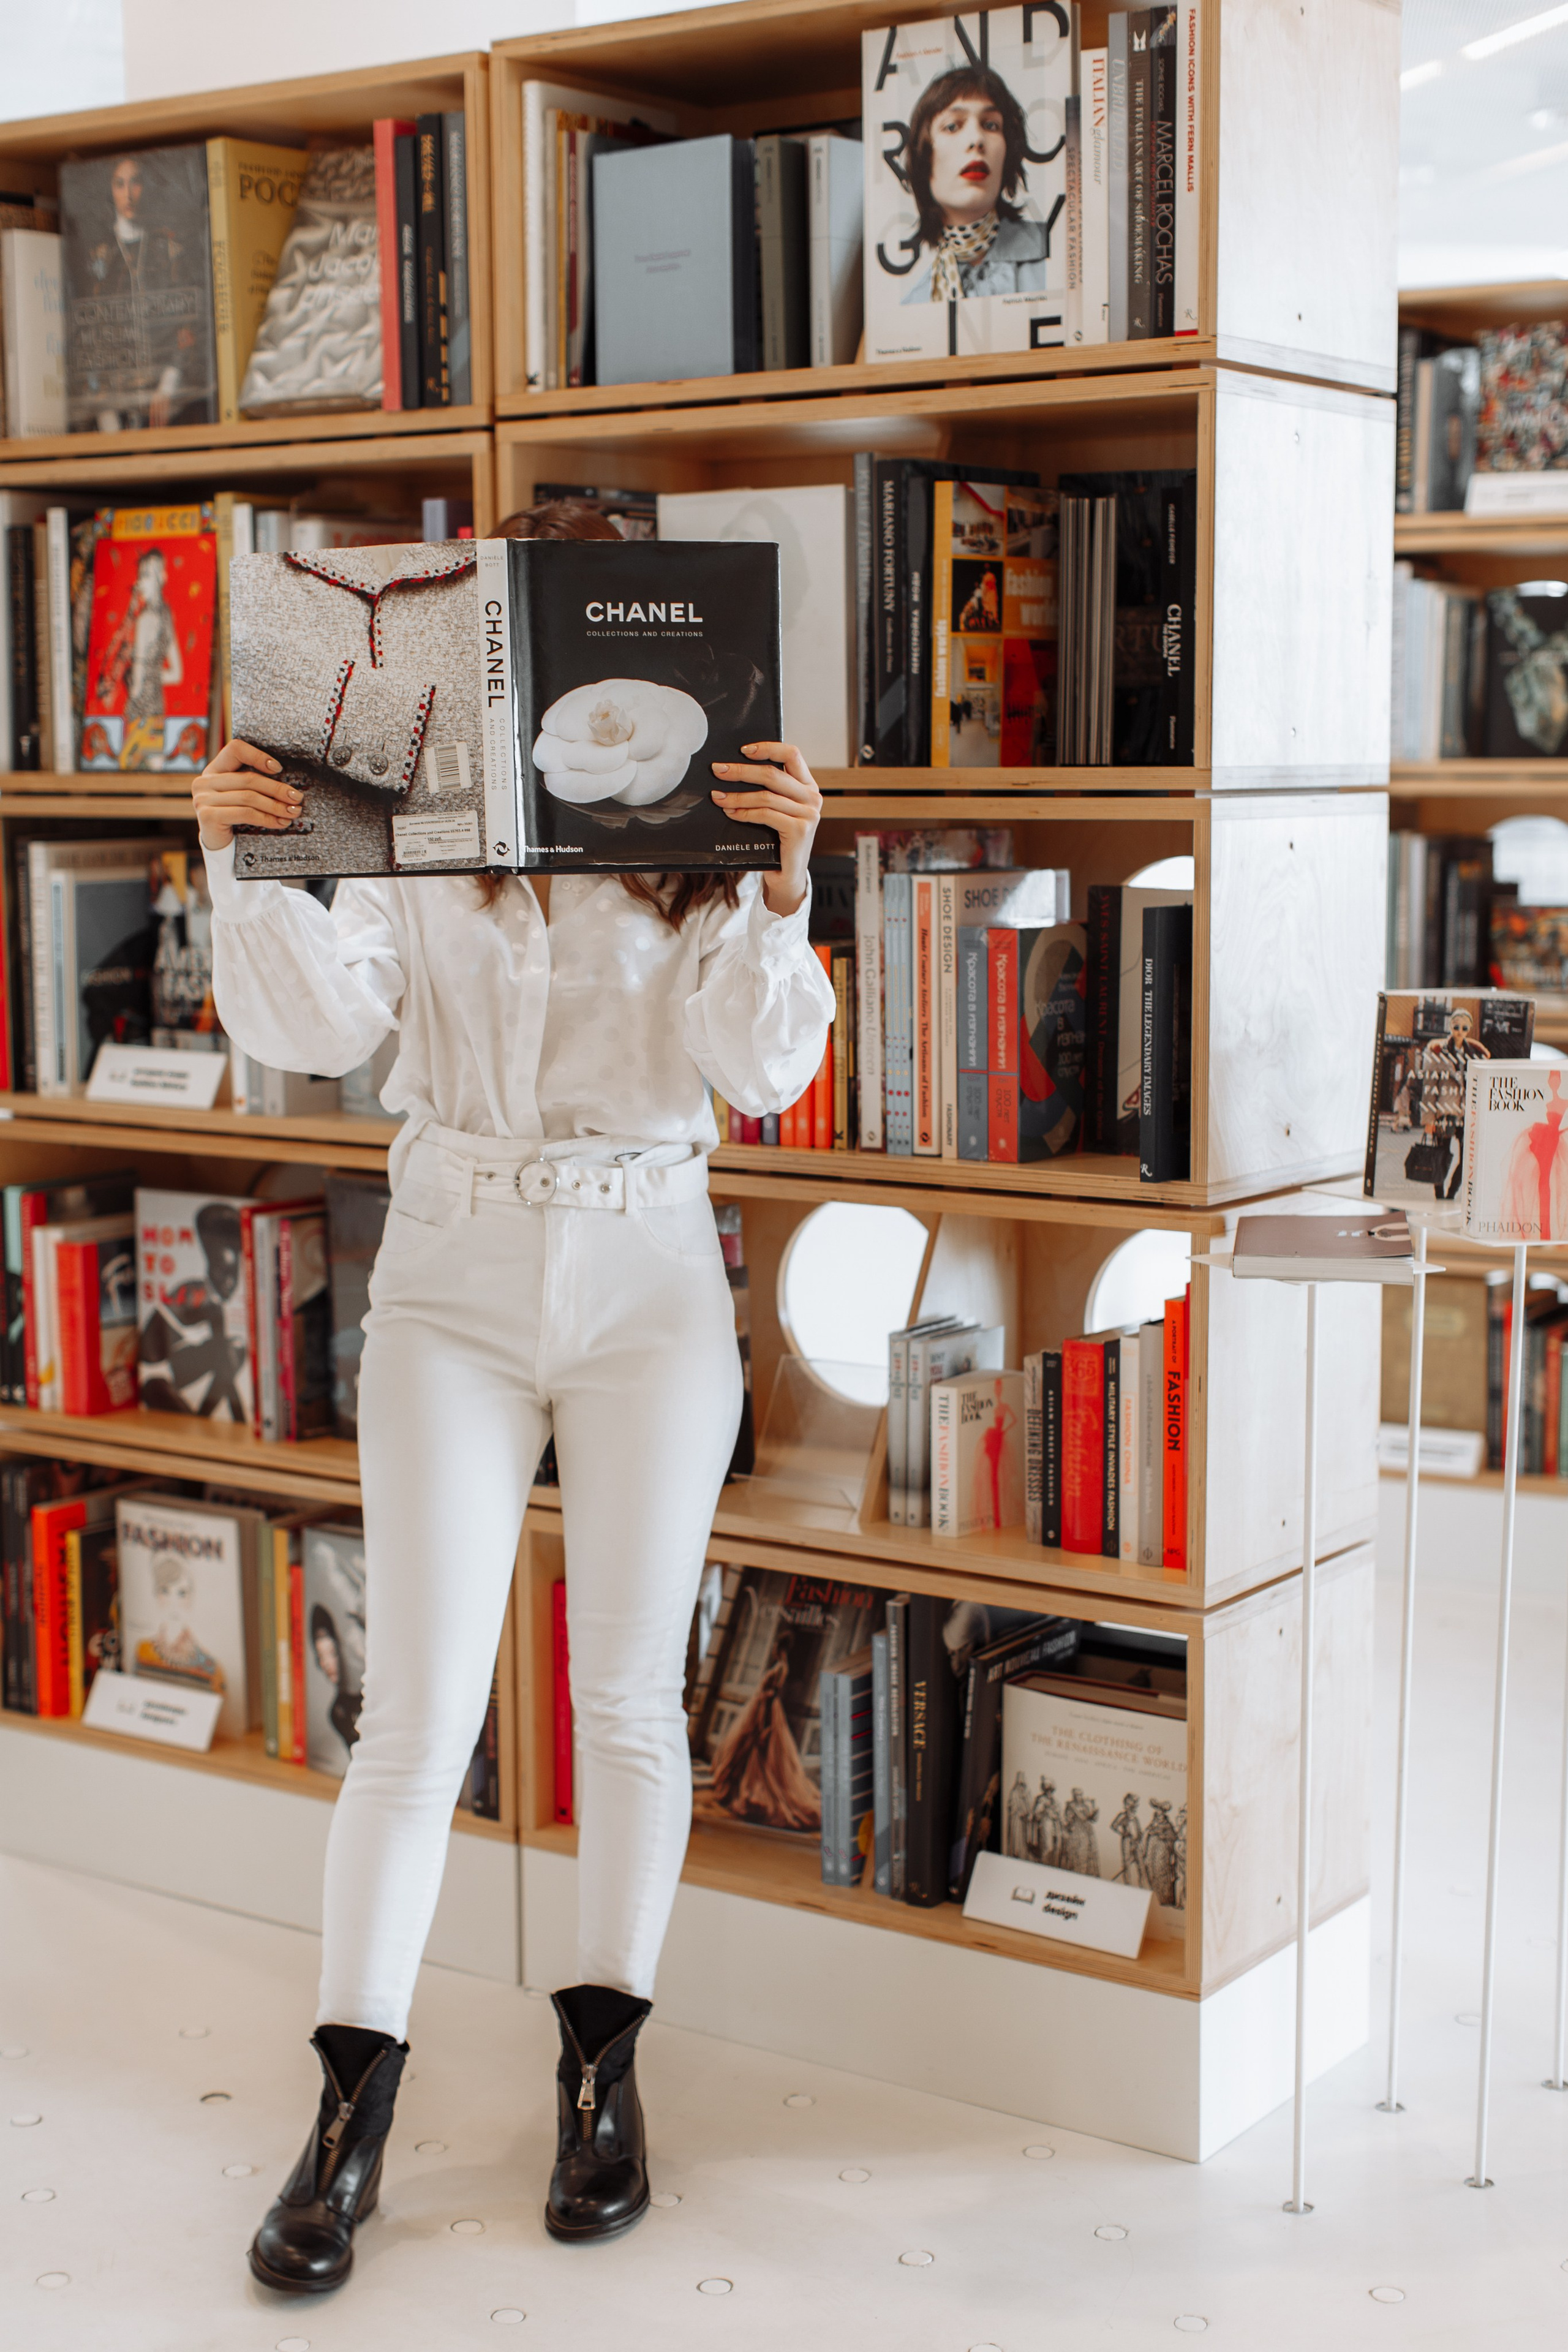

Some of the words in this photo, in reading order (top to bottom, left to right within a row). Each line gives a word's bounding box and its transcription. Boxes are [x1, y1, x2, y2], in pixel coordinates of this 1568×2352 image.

[1093, 58, 1105, 127] ITALIAN
[1134, 79, 1144, 104] THE
[1134, 107, 1144, 156] ITALIAN
[1090, 127, 1105, 184] glamour
[1134, 159, 1144, 183] ART
[1156, 121, 1174, 198] MARCEL
[1067, 148, 1076, 232] SPECTACULAR
[1134, 184, 1144, 199] OF
[1134, 203, 1144, 284] SHOEMAKING
[1155, 203, 1173, 285] ROCHAS
[1067, 238, 1076, 290] FASHION
[883, 480, 895, 547] MARIANO
[883, 549, 895, 612] FORTUNY
[586, 601, 703, 622] CHANEL
[485, 600, 505, 708] CHANEL
[1167, 604, 1182, 677] CHANEL
[499, 718, 508, 791] COLLECTIONS
[715, 843, 750, 851] DANIÈLE
[943, 888, 952, 921] SHOE
[963, 888, 998, 909] SHOE
[864, 935, 876, 965] John
[943, 925, 953, 974] DESIGN
[966, 952, 978, 1002] Красота
[995, 954, 1008, 1004] Красота
[1144, 958, 1153, 984] DIOR
[864, 967, 877, 1023] Galliano
[1144, 990, 1153, 1012] THE
[1144, 1013, 1153, 1074] LEGENDARY
[921, 1075, 929, 1084] of
[1407, 1069, 1450, 1080] ASIAN
[1424, 1085, 1463, 1096] FASHI
[1489, 1088, 1545, 1101] FASHION
[1490, 1077, 1518, 1088] THE
[1143, 1076, 1152, 1115] IMAGES
[1488, 1099, 1526, 1112] BOOK
[1468, 1109, 1477, 1180] FASHION
[1479, 1221, 1543, 1234] PHAIDON
[144, 1253, 177, 1275] TO
[938, 1394, 950, 1425] THE
[1107, 1381, 1116, 1421] MILITARY
[1167, 1370, 1181, 1451] FASHION
[1107, 1422, 1116, 1449] STYLE
[938, 1425, 950, 1487] FASHION
[1107, 1450, 1116, 1489] INVADES
[1027, 1458, 1042, 1502] DRESSES
[938, 1487, 950, 1532] BOOK
[1107, 1490, 1115, 1531] FASHION
[122, 1521, 223, 1561] FASHION
[913, 1681, 928, 1750] VERSACE
[1031, 1731, 1052, 1746] THE
[1055, 1739, 1137, 1763] RENAISSANCE
[1052, 1725, 1074, 1738] THE
[1077, 1732, 1144, 1752] CLOTHING
[1147, 1744, 1162, 1756] OF
[1042, 1903, 1078, 1921] design
[1046, 1891, 1086, 1907] дизайн
